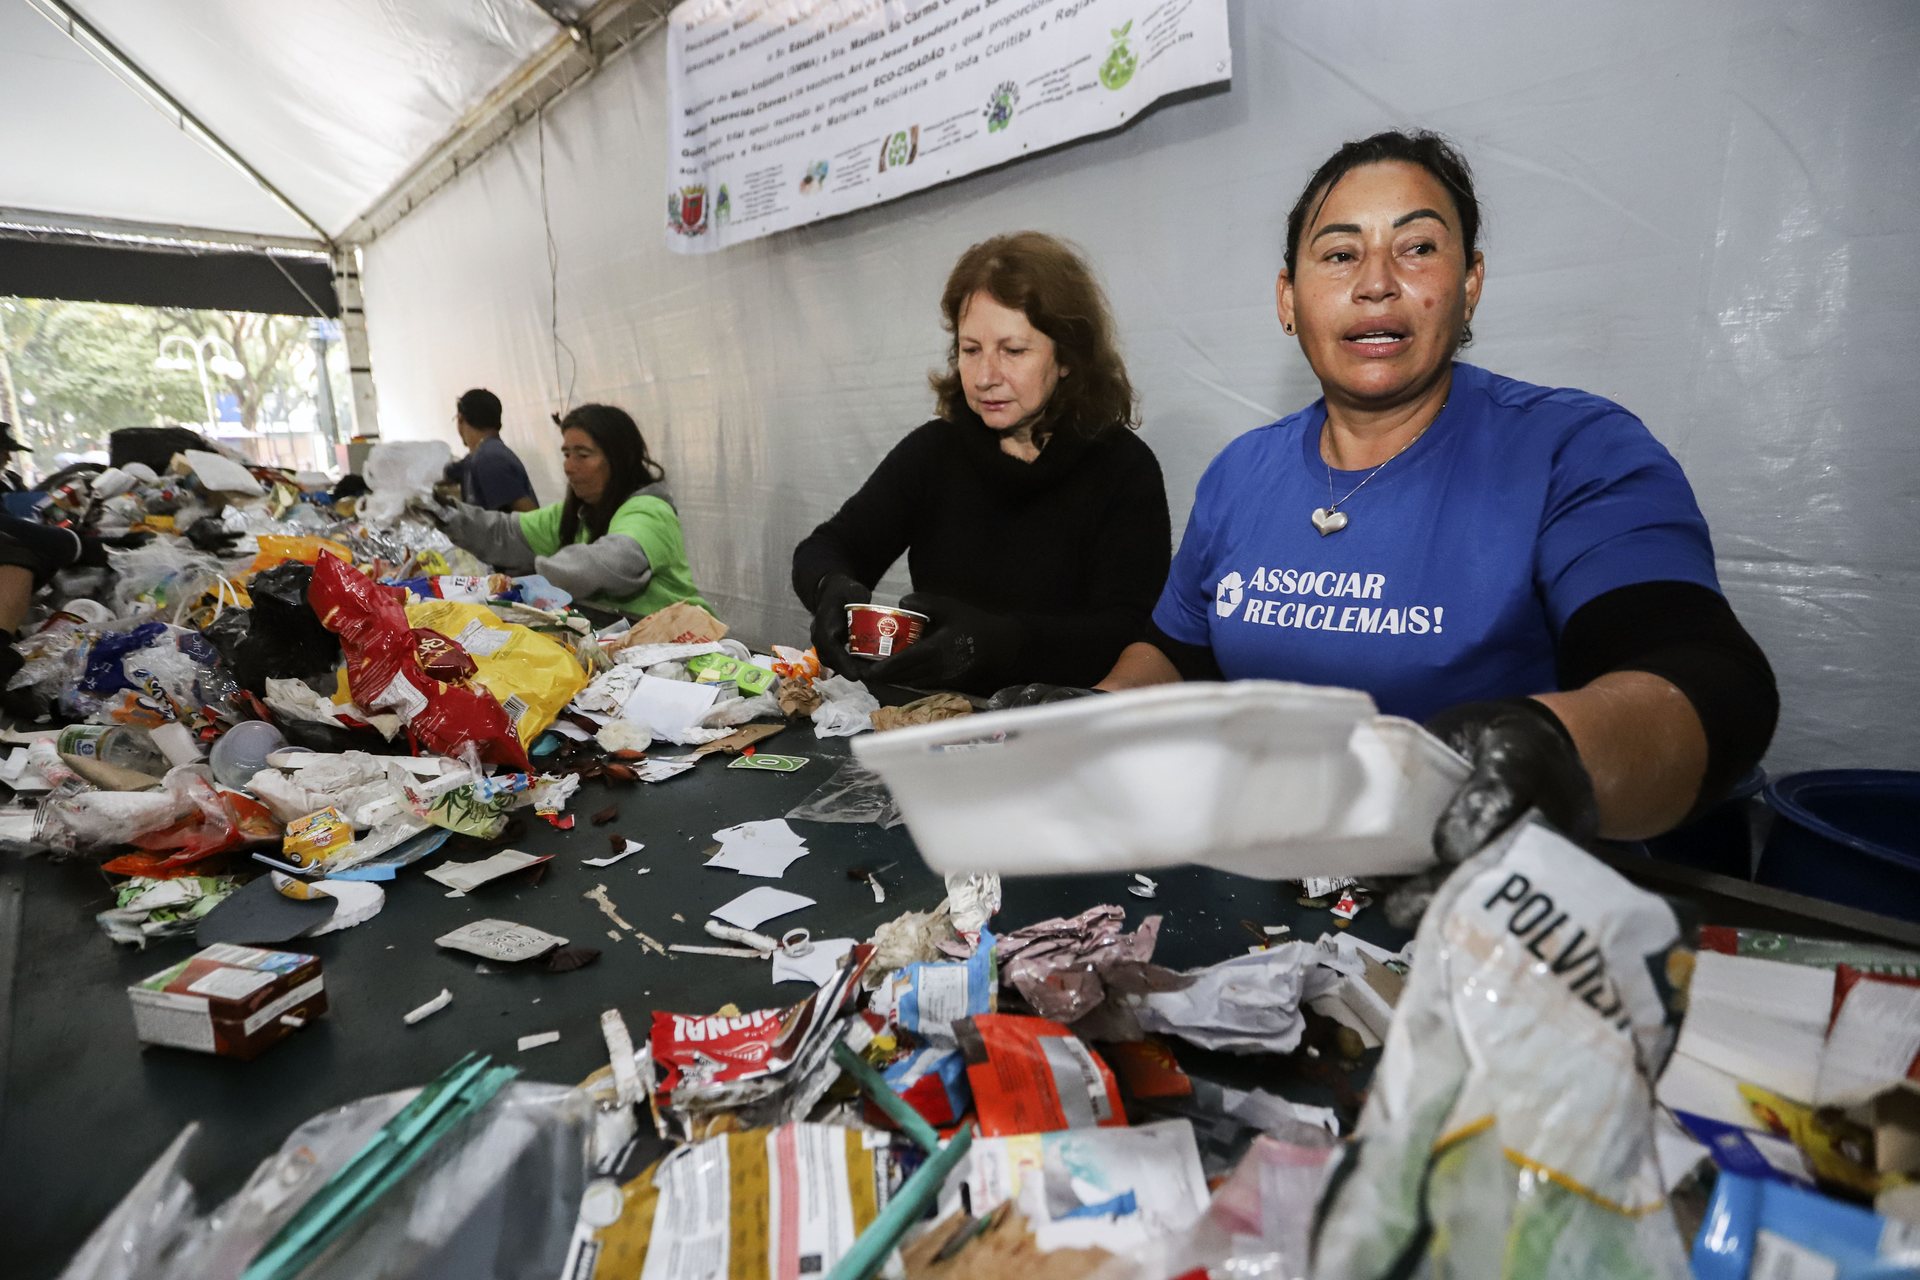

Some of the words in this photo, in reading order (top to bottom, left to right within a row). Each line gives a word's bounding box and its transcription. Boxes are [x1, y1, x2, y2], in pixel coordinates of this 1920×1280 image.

[903, 1, 939, 25] Carmo
[789, 30, 826, 53] Eduardo
[985, 28, 1032, 57] Curitiba
[873, 46, 945, 88] ECO-CIDADÃO
[1248, 566, 1386, 600] ASSOCIAR
[1243, 597, 1444, 635] RECICLEMAIS!
